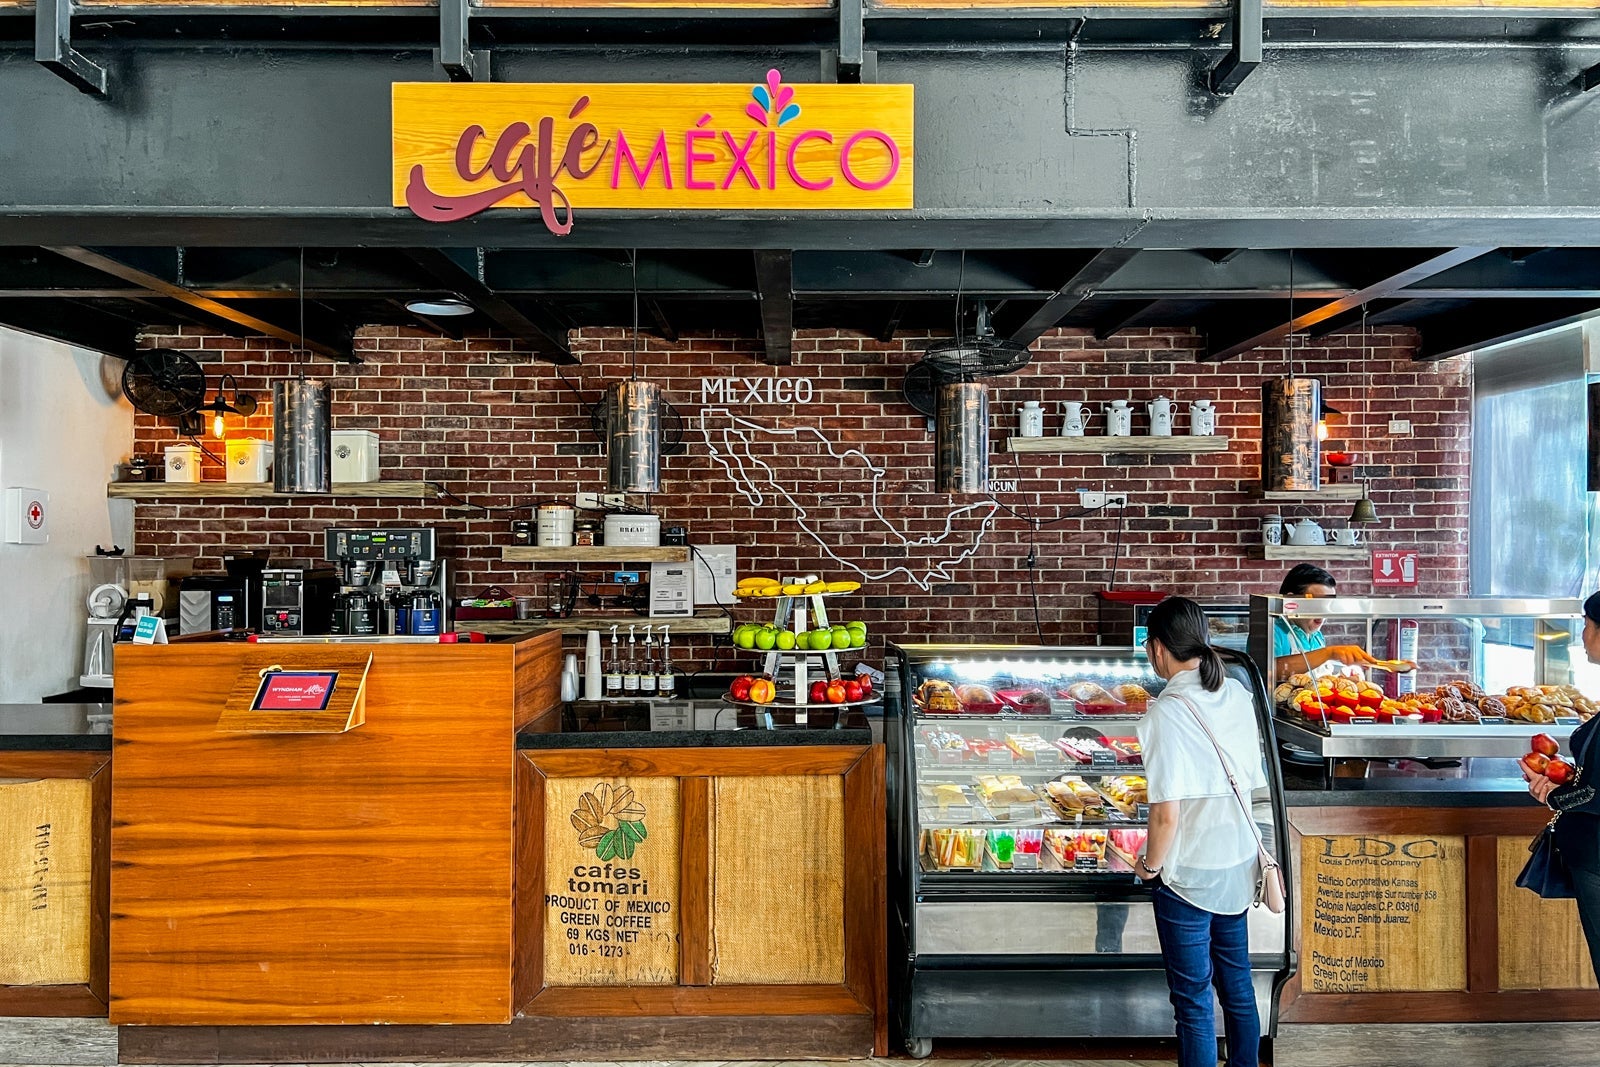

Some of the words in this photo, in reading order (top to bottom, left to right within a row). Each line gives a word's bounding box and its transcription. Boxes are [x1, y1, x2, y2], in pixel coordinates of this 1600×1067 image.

[405, 95, 611, 236] café
[610, 113, 900, 191] MÉXICO
[701, 377, 813, 404] MEXICO
[1319, 836, 1438, 859] LDC
[1319, 856, 1343, 866] Louis
[1345, 858, 1378, 867] Dreyfus
[1380, 858, 1422, 868] Company
[573, 863, 641, 880] cafes
[567, 878, 648, 895] tomari
[1317, 874, 1344, 887] Edificio
[1345, 877, 1389, 889] Corporativo
[1391, 879, 1419, 888] Kansas
[1317, 886, 1344, 899] Avenida
[1384, 889, 1397, 899] Sur
[1424, 890, 1438, 900] 858
[544, 895, 599, 911] PRODUCT
[604, 899, 620, 912] OF
[626, 900, 671, 914] MEXICO
[1316, 898, 1344, 912] Colonia
[1345, 901, 1377, 913] Napoles
[560, 912, 600, 926] GREEN
[606, 915, 652, 928] COFFEE
[1314, 909, 1356, 925] Delegacion
[1357, 913, 1381, 924] Benito
[566, 928, 579, 940] 69
[585, 928, 610, 942] KGS
[616, 930, 639, 943] NET
[1313, 921, 1343, 938] Mexico
[1344, 926, 1362, 938] D.F.
[569, 943, 589, 956] 016
[598, 944, 623, 958] 1273
[1312, 950, 1344, 968] Product
[1344, 956, 1354, 968] of
[1354, 956, 1385, 968] Mexico
[1312, 964, 1338, 981] Green
[1340, 969, 1369, 982] Coffee
[1313, 978, 1325, 991] 69
[1326, 981, 1345, 992] KGS
